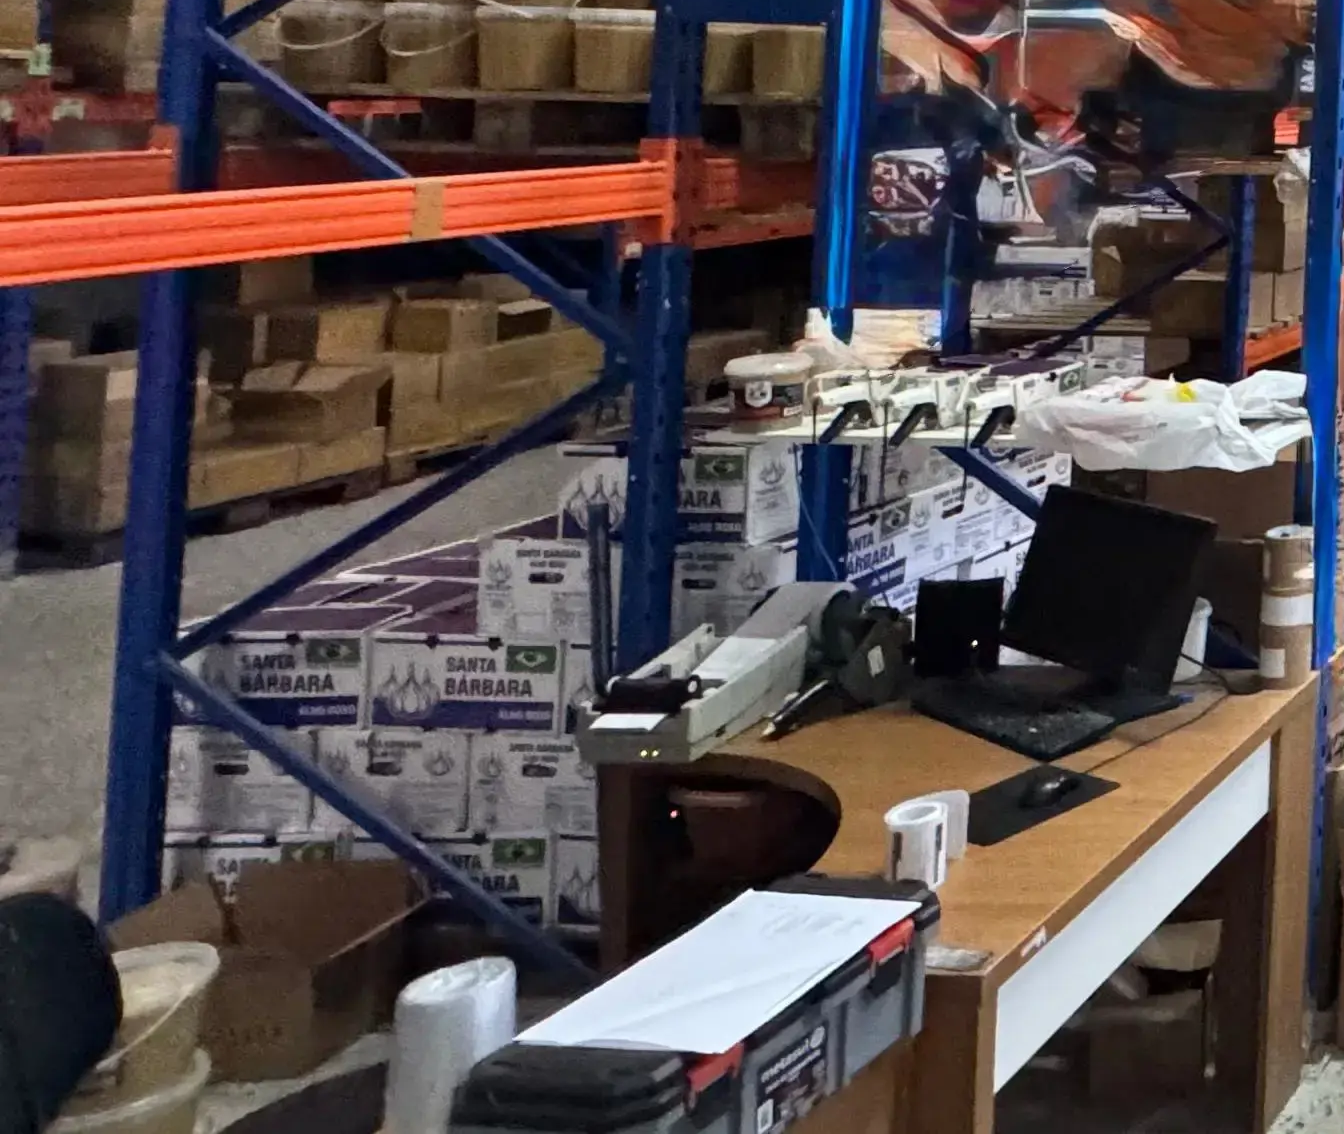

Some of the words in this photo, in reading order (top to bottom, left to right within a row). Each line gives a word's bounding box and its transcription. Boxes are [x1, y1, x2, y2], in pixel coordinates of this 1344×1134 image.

[681, 489, 722, 509] ARA
[240, 654, 296, 671] SANTA
[446, 656, 497, 674] SANTA
[240, 672, 335, 694] BÁRBARA
[444, 675, 533, 698] BÁRBARA
